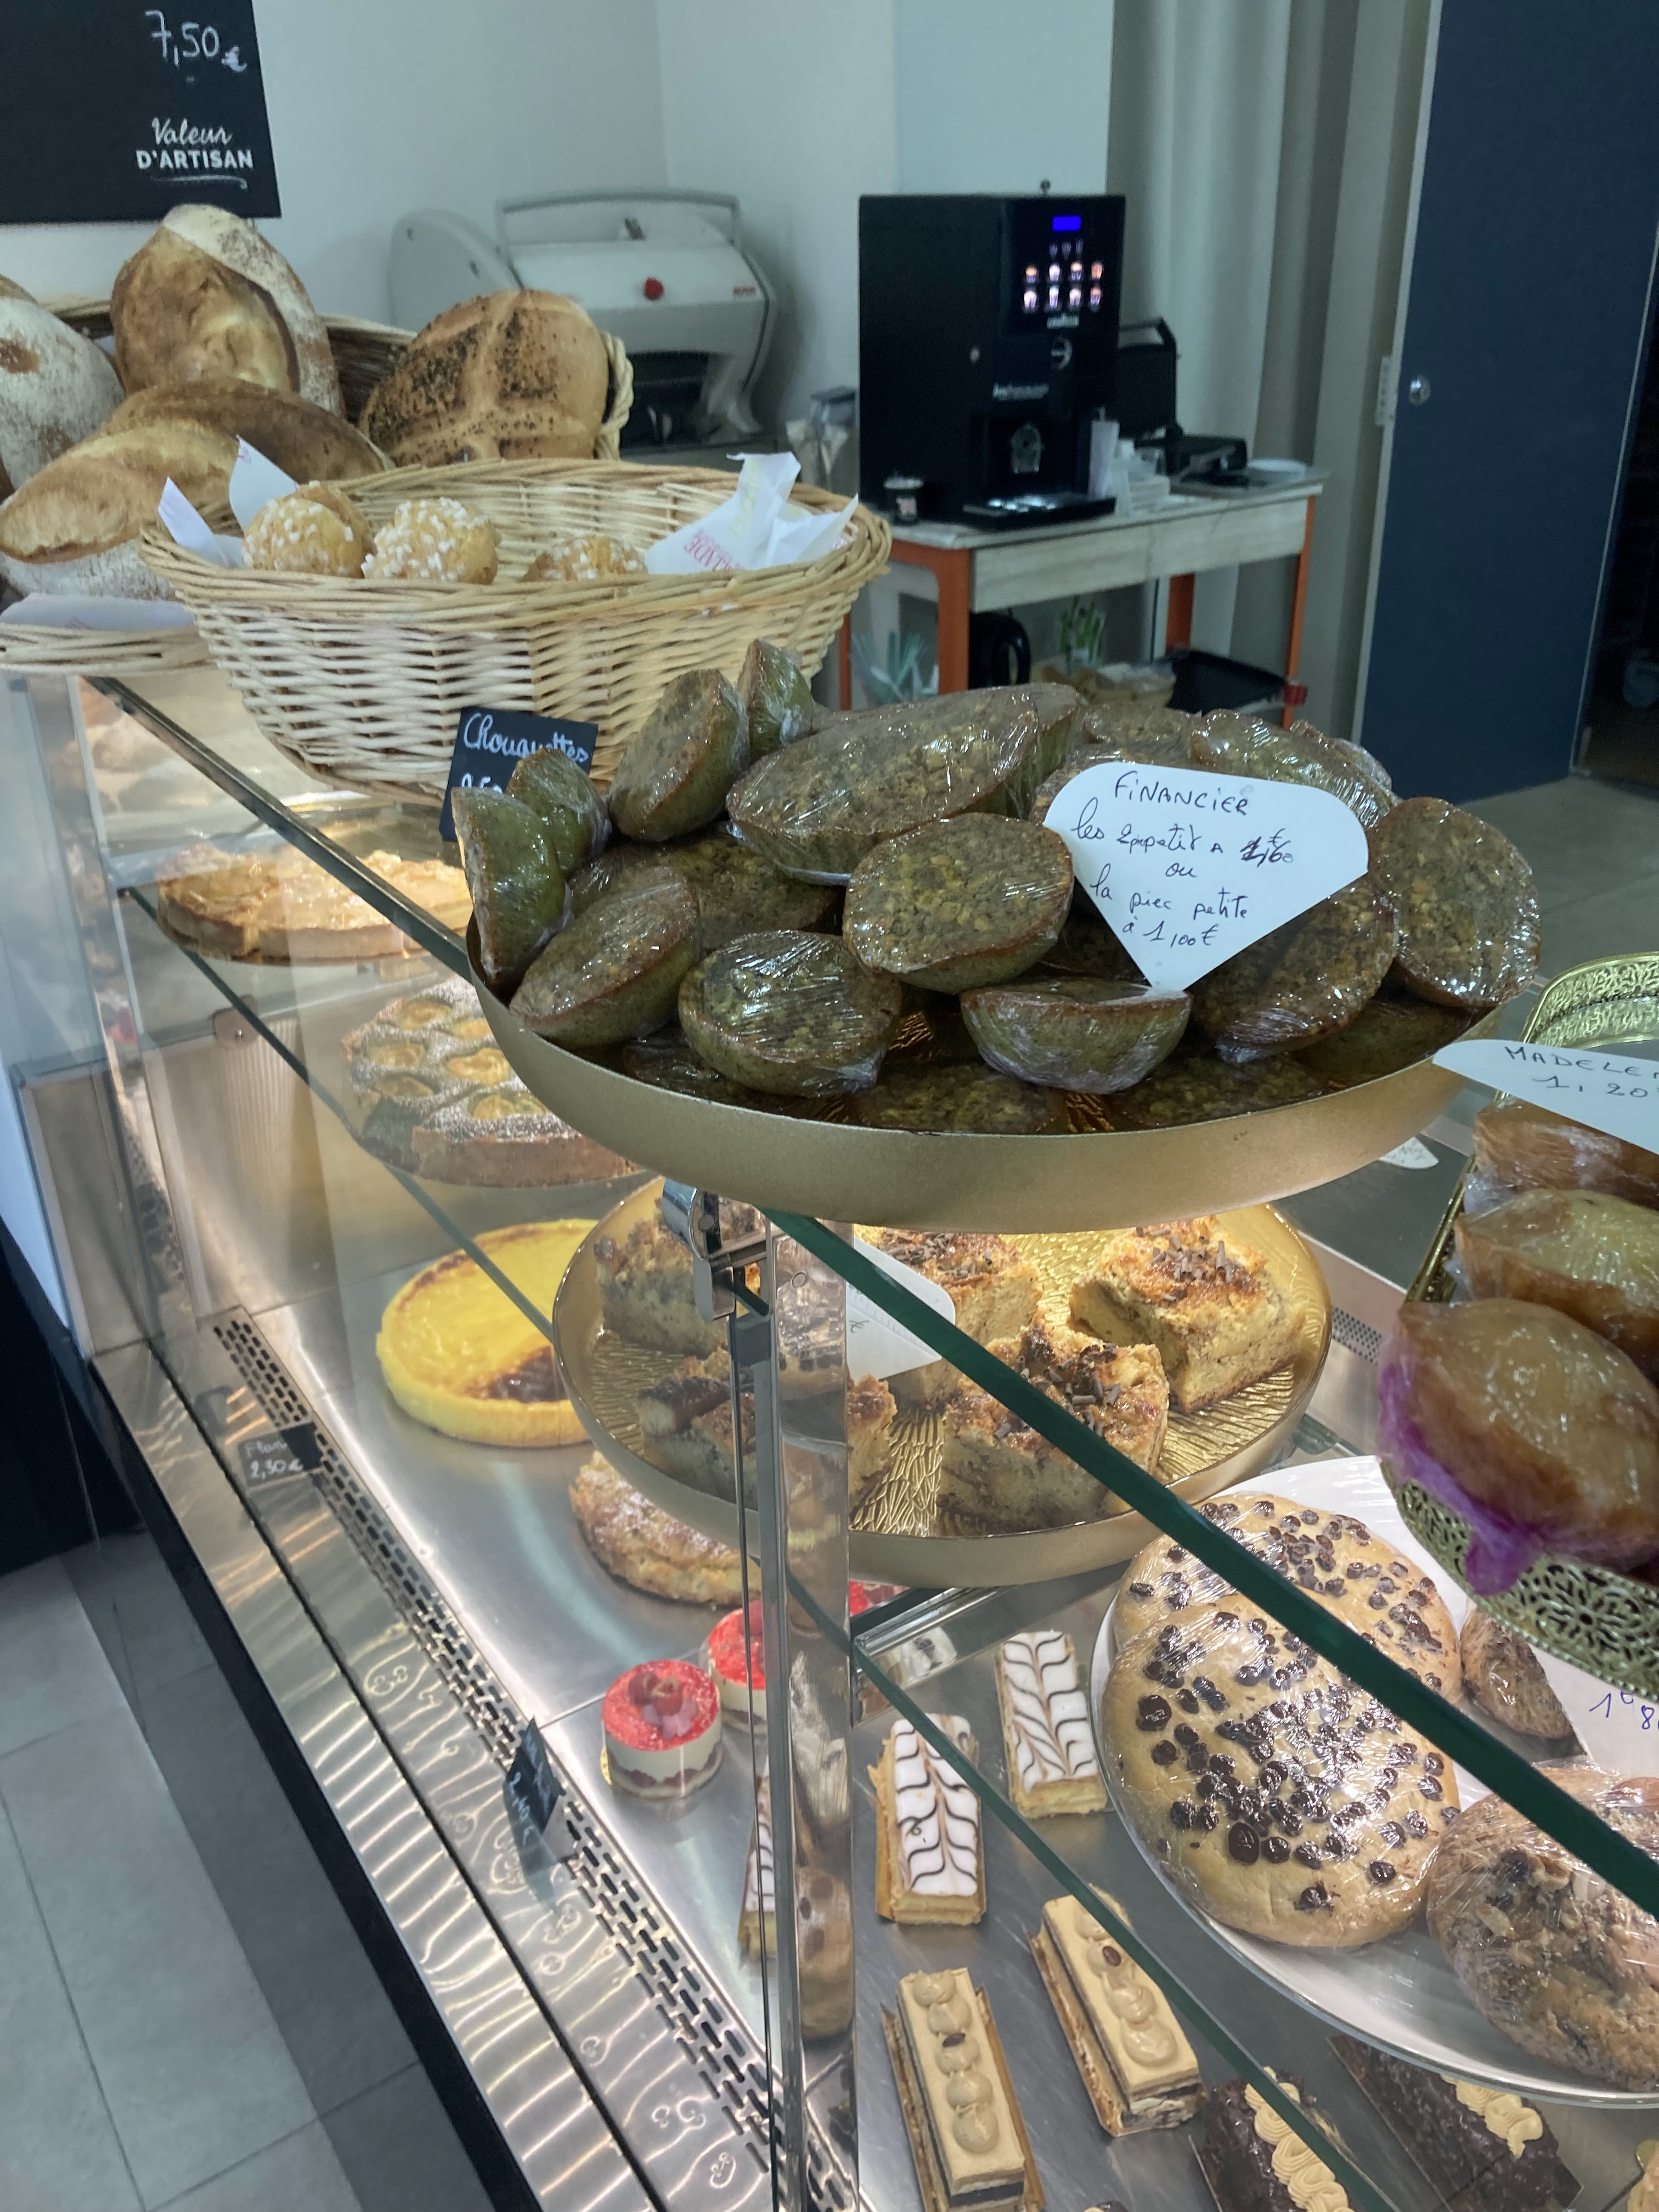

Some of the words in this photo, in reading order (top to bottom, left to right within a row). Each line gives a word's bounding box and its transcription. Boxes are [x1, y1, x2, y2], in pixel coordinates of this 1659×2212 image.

[151, 116, 234, 146] Valeur
[136, 149, 254, 170] D'ARTISAN
[1070, 797, 1104, 839] les
[1090, 863, 1113, 900] la
[1165, 862, 1198, 878] ou
